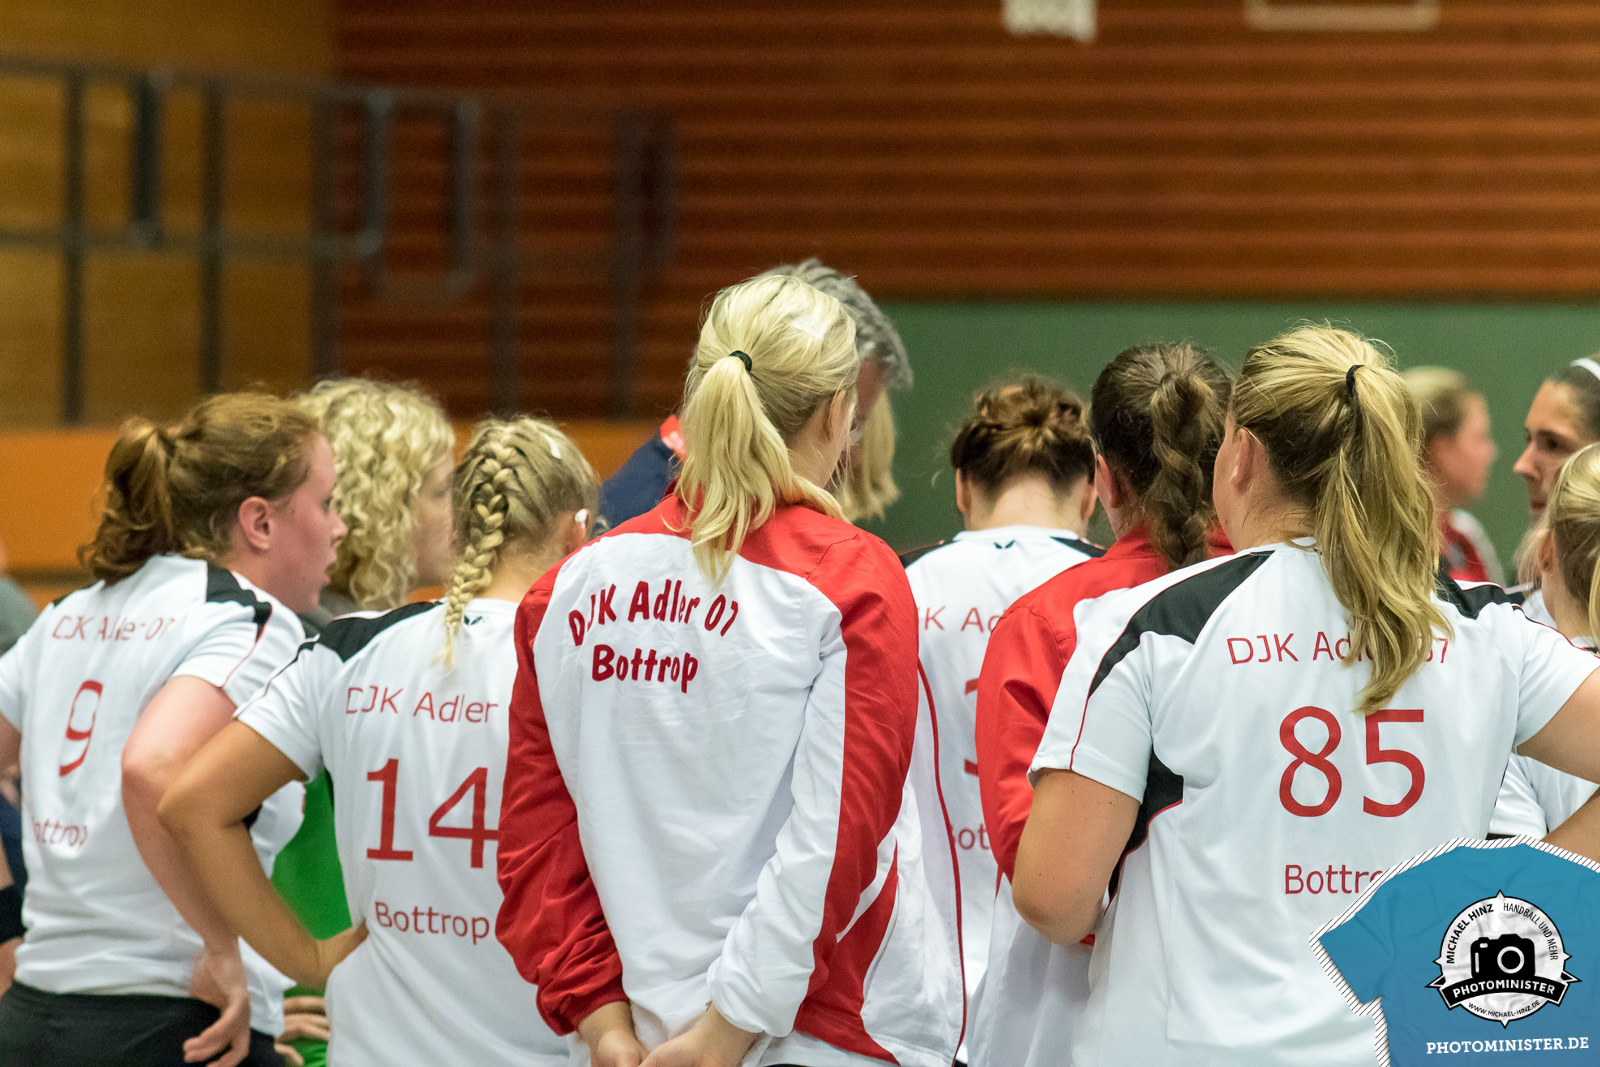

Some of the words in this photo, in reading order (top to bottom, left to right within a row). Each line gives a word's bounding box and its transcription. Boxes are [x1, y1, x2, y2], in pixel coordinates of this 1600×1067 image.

[568, 583, 617, 647] DJK
[627, 578, 701, 625] Adler
[704, 593, 740, 638] 07
[591, 643, 699, 694] Bottrop
[1226, 632, 1299, 665] DJK
[59, 679, 104, 778] 9
[412, 692, 500, 724] Adler
[1279, 705, 1426, 818] 85
[366, 757, 500, 869] 14
[1284, 864, 1384, 895] Bottr
[374, 901, 490, 945] Bottrop
